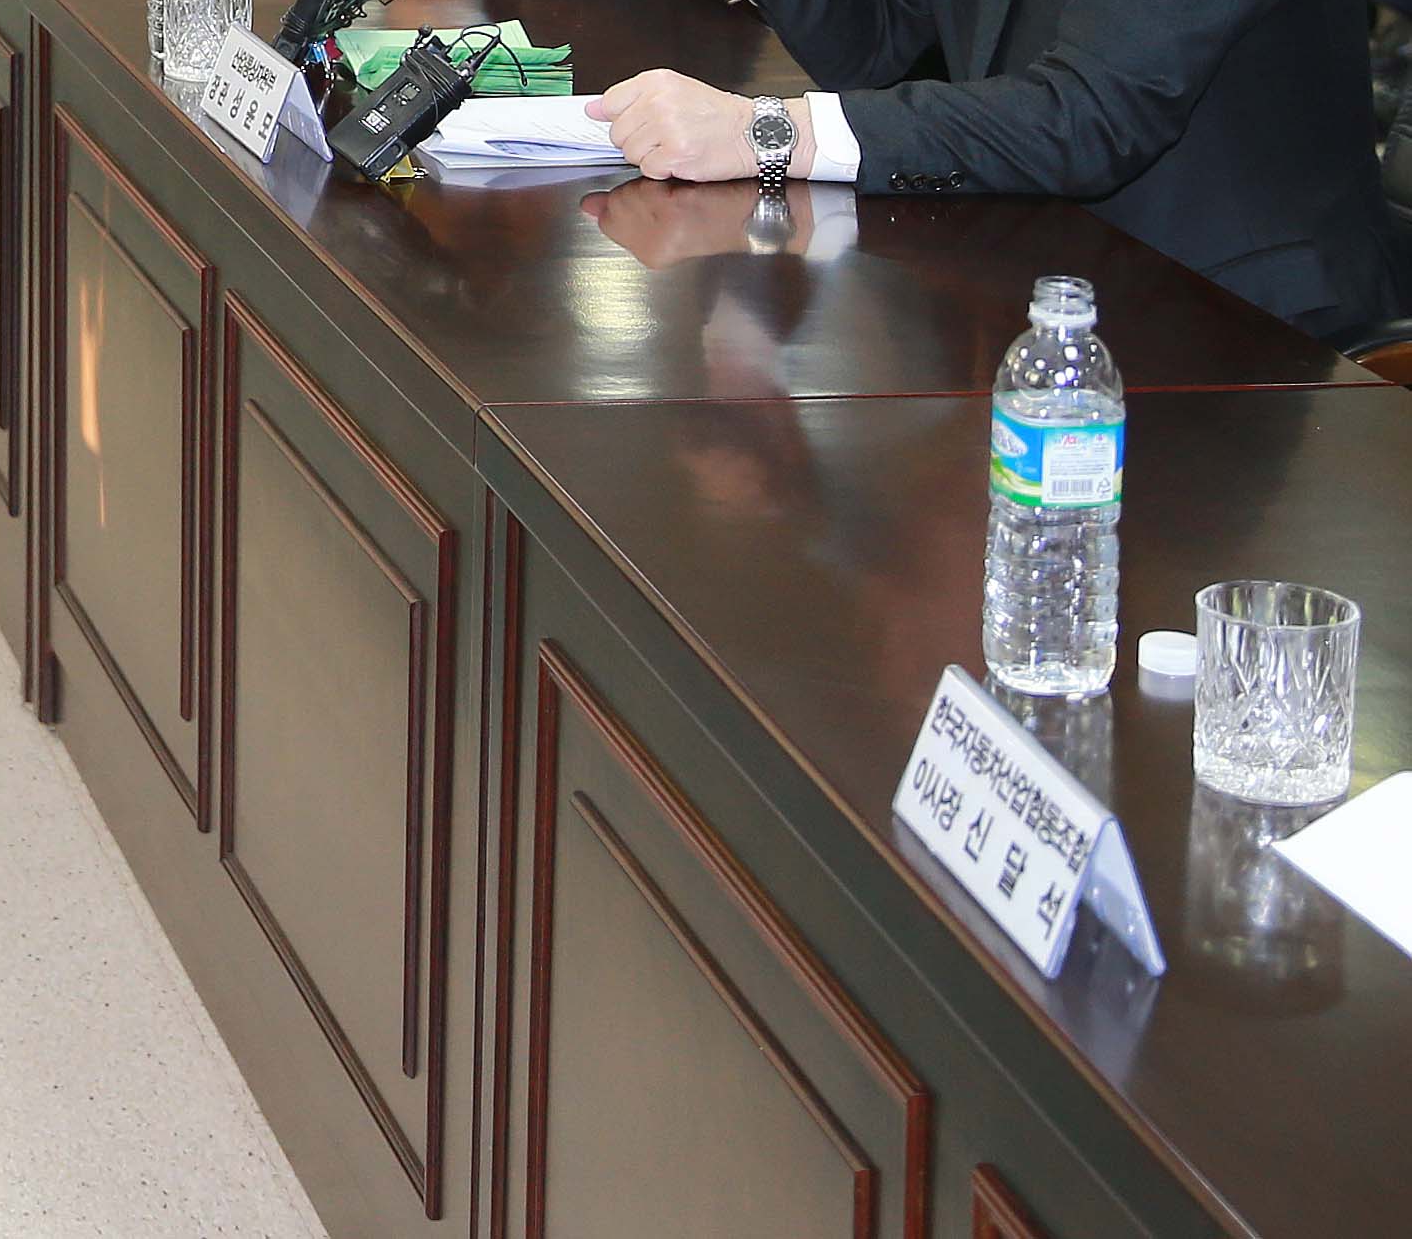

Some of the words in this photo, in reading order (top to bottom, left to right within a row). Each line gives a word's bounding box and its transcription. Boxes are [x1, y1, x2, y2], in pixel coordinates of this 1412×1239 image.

[231, 47, 278, 95] 산업통상자원부
[912, 760, 963, 832] 이사장
[931, 694, 1091, 875] 한국자동차산업협동조합
